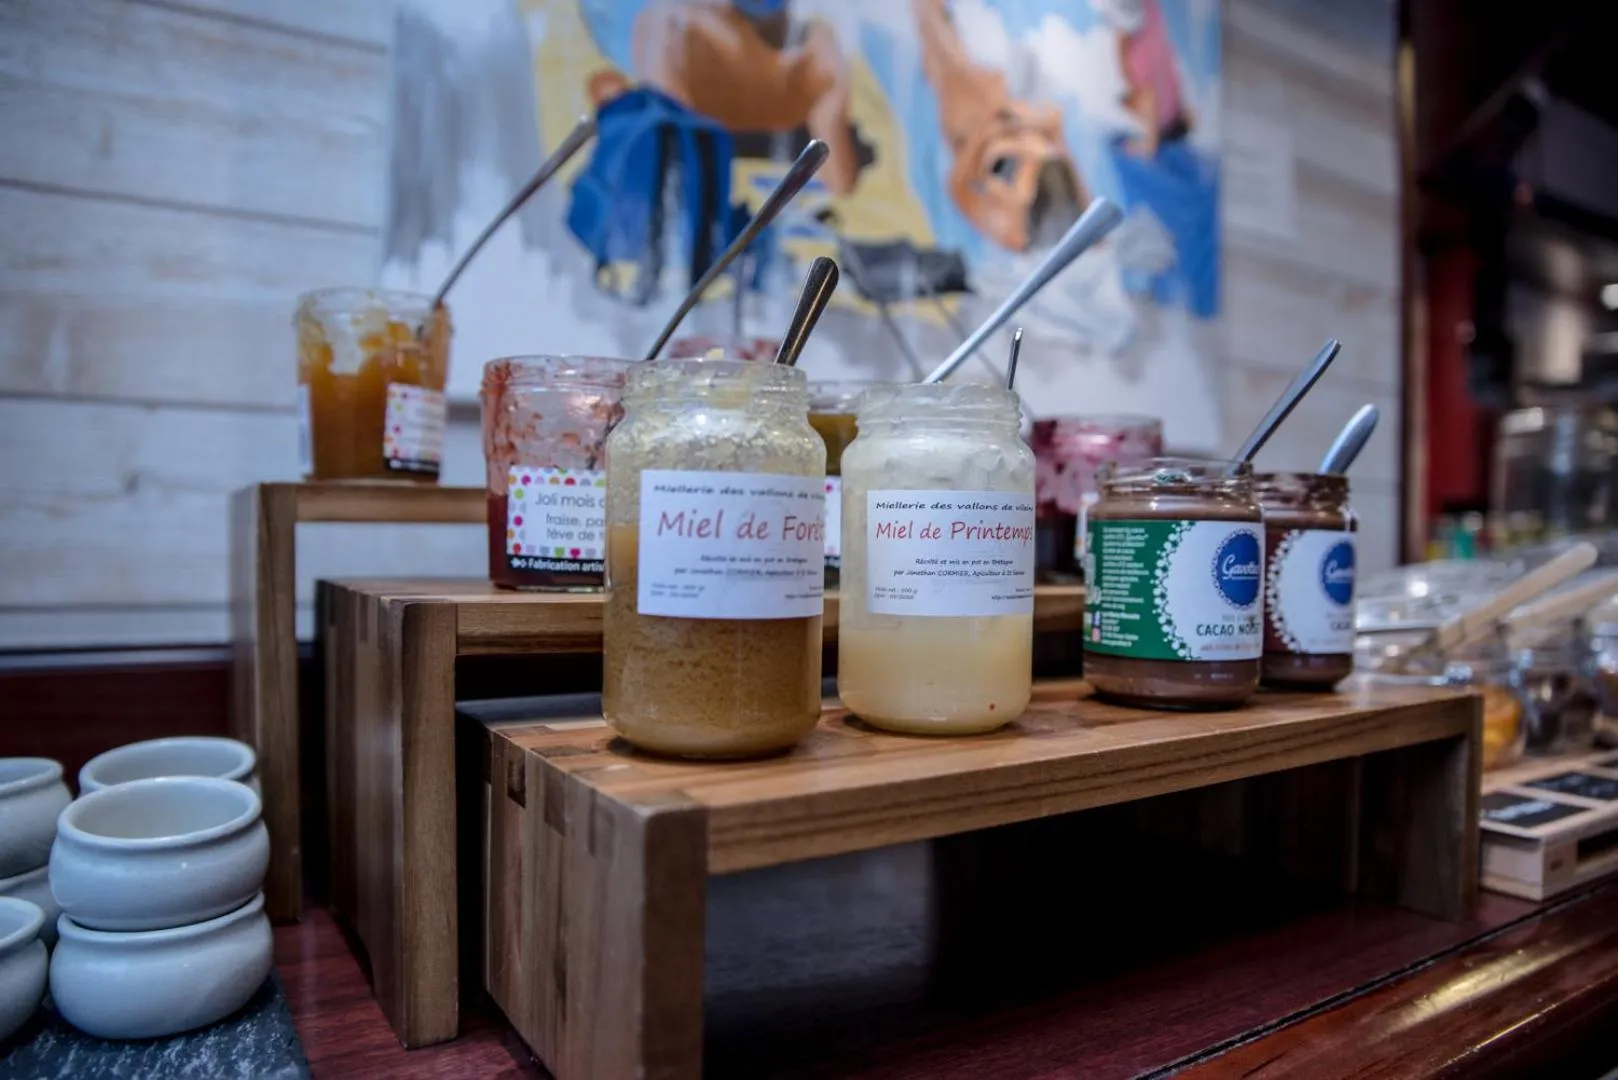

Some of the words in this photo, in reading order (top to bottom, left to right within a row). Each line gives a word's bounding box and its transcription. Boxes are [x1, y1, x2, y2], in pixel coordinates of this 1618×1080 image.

[535, 492, 557, 506] Joli
[561, 494, 596, 508] mois
[875, 502, 926, 510] Miellerie
[930, 502, 952, 510] des
[957, 502, 998, 511] vallons
[1001, 503, 1013, 511] de
[657, 508, 724, 539] Miel
[736, 511, 769, 540] de
[876, 520, 914, 540] Miel
[920, 522, 942, 540] de
[578, 530, 596, 541] de
[528, 557, 581, 571] Fabrication
[1196, 624, 1235, 636] CACAO
